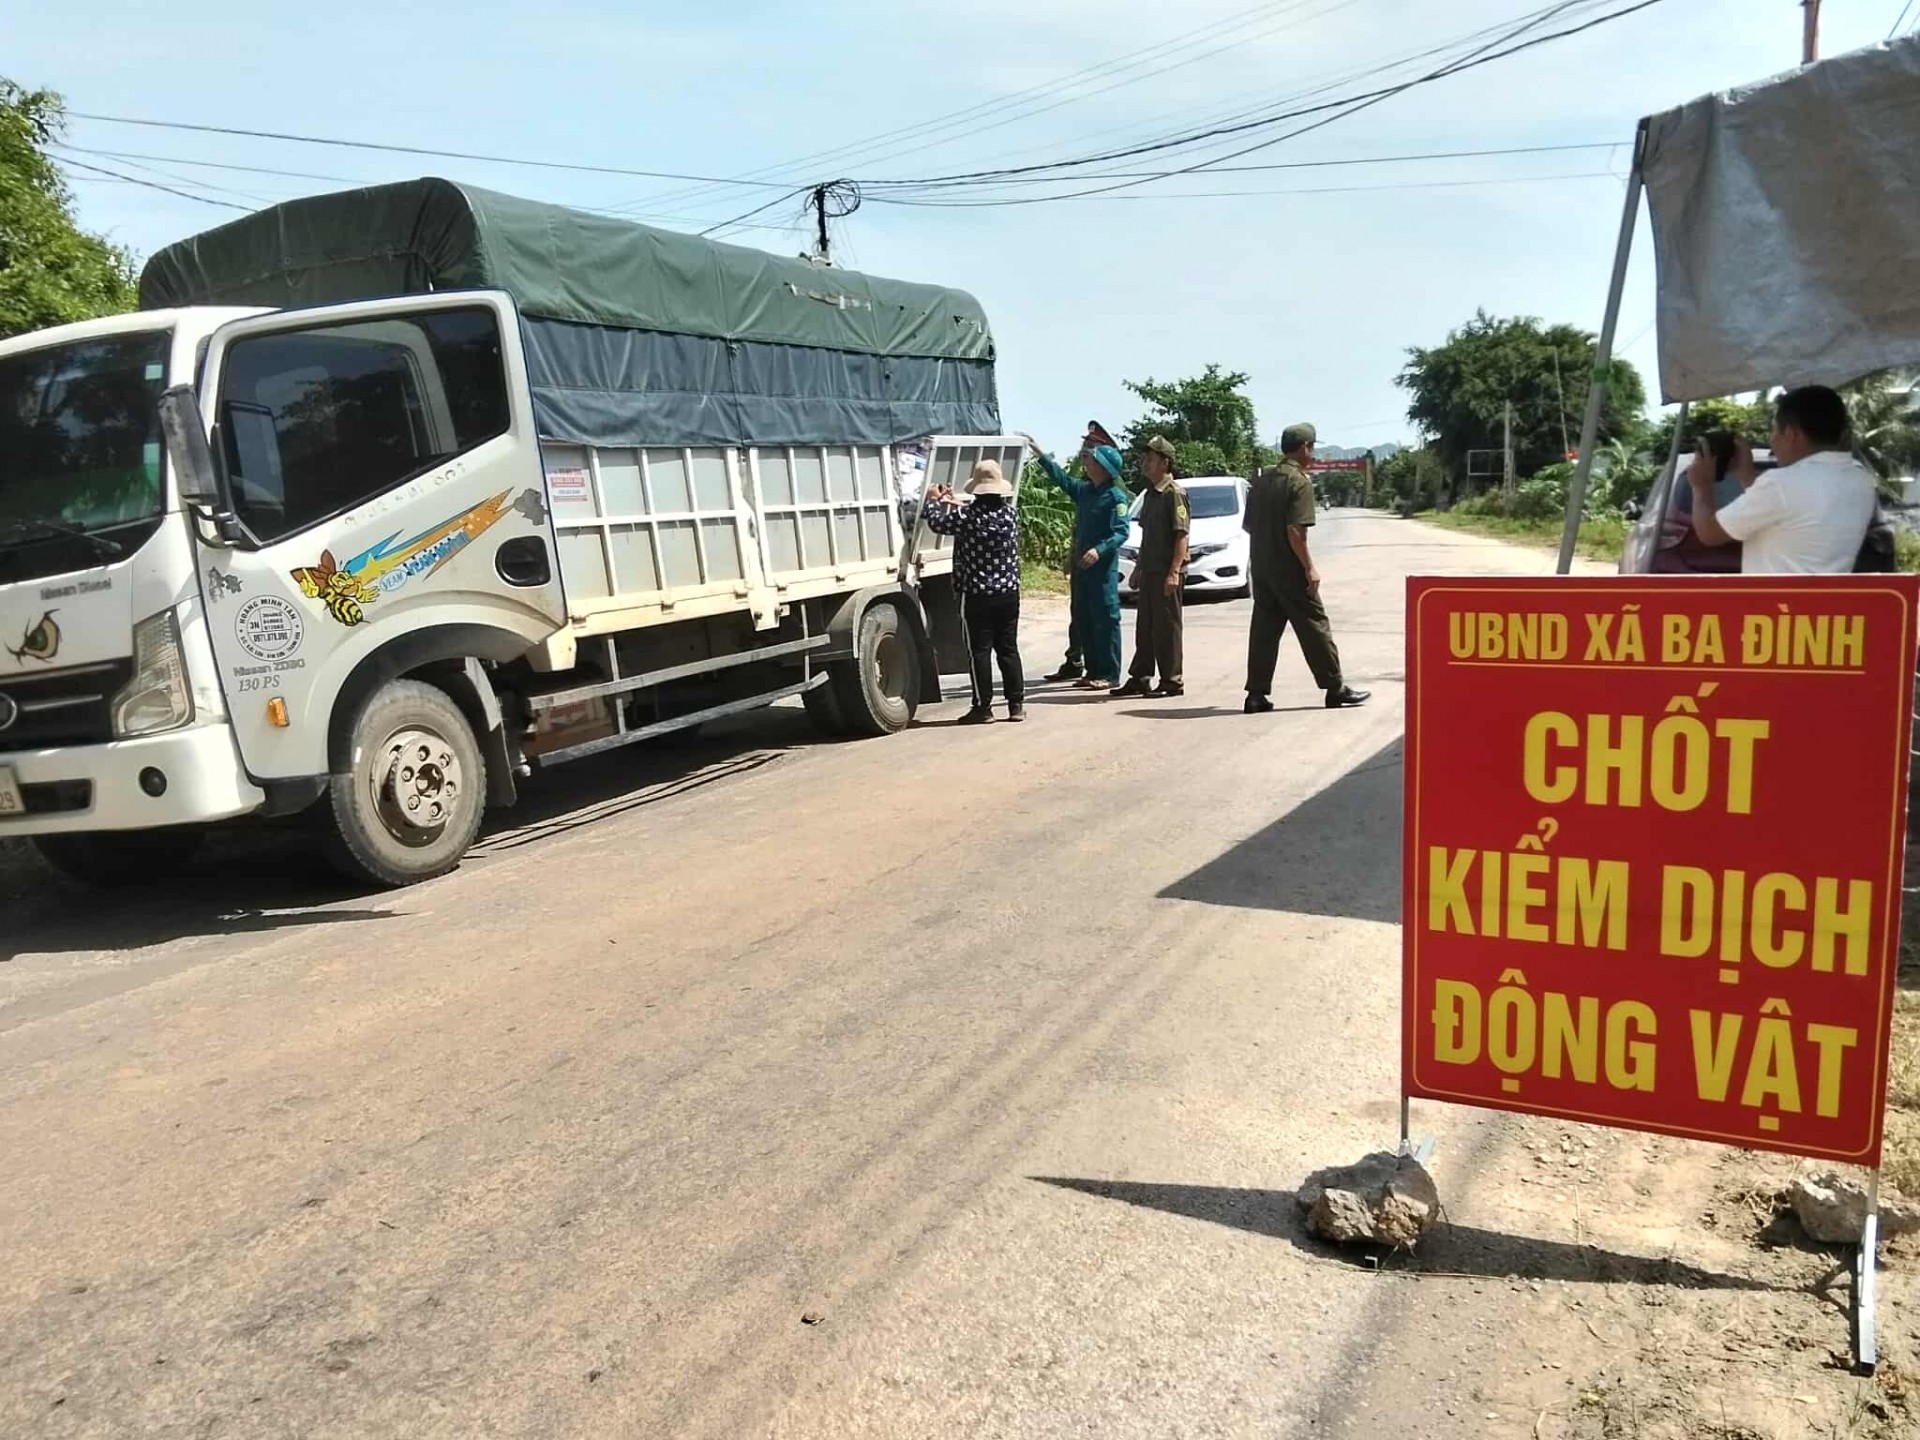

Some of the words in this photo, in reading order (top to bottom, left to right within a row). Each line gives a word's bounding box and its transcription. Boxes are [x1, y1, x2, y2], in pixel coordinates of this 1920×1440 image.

[238, 677, 260, 692] 130
[262, 674, 280, 689] PS
[1450, 612, 1568, 660] UBND
[1584, 604, 1645, 662] XÃ
[1662, 614, 1725, 664] BA
[1742, 603, 1864, 666] ĐÌNH
[1523, 682, 1770, 815] CHỐT
[1428, 816, 1630, 951] KIỂM
[1660, 865, 1873, 984] DỊCH
[1431, 968, 1657, 1093] ĐỘNG
[1689, 998, 1857, 1131] VẬT
